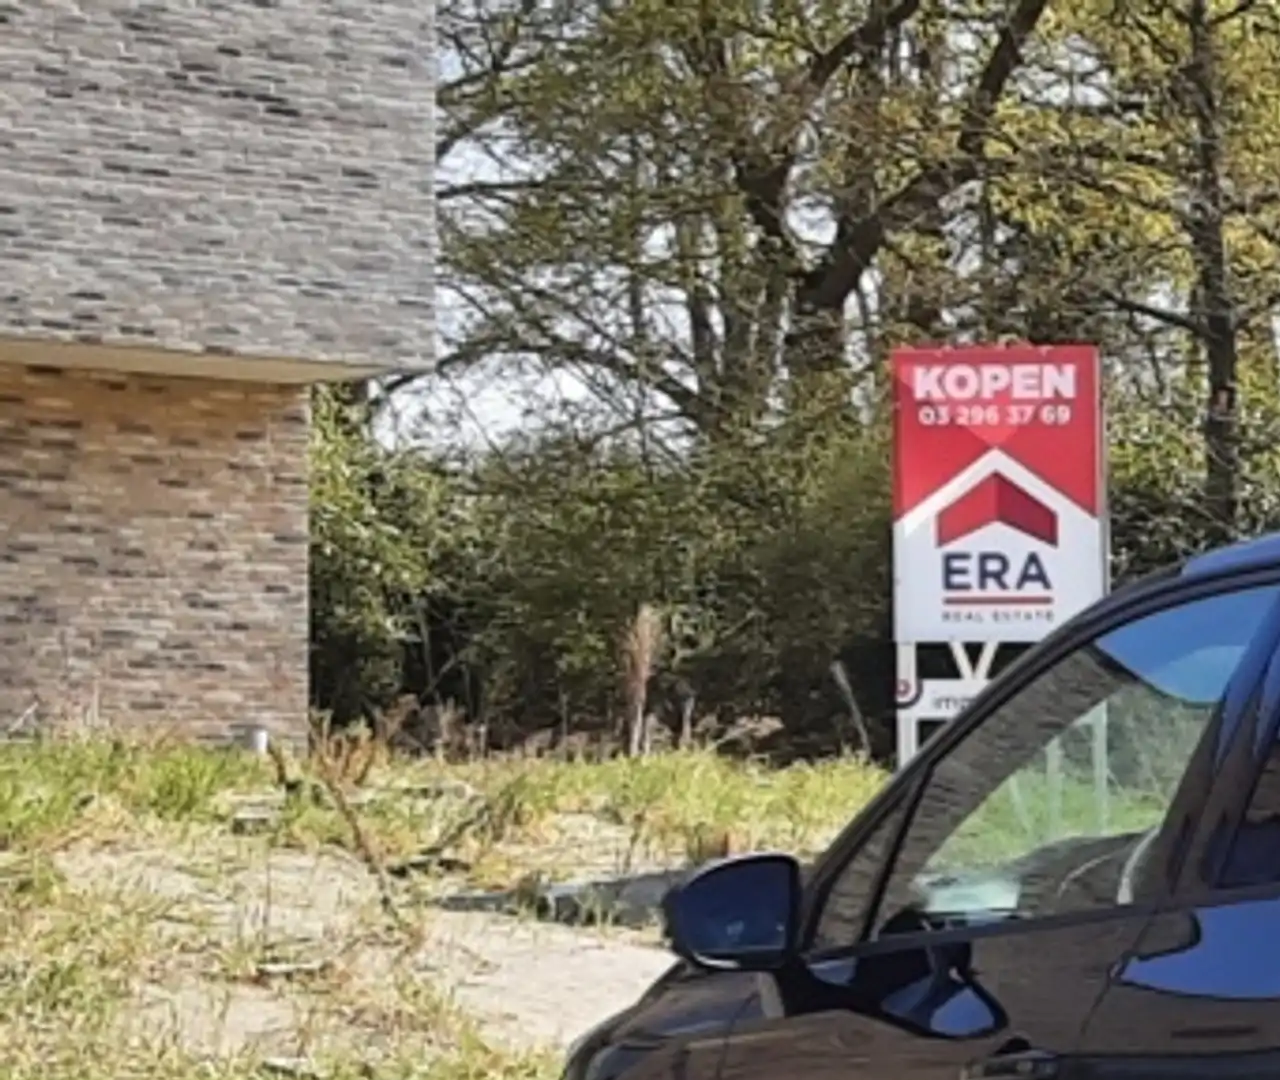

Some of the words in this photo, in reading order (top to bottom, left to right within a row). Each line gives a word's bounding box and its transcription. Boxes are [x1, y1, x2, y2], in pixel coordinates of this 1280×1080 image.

[913, 364, 1076, 399] KOPEN
[918, 405, 949, 425] 03
[955, 405, 1000, 425] 296
[1006, 405, 1036, 425] 37
[1041, 405, 1071, 425] 69
[942, 551, 1053, 591] ERA
[942, 611, 984, 622] REAL
[992, 610, 1054, 623] ESTATE
